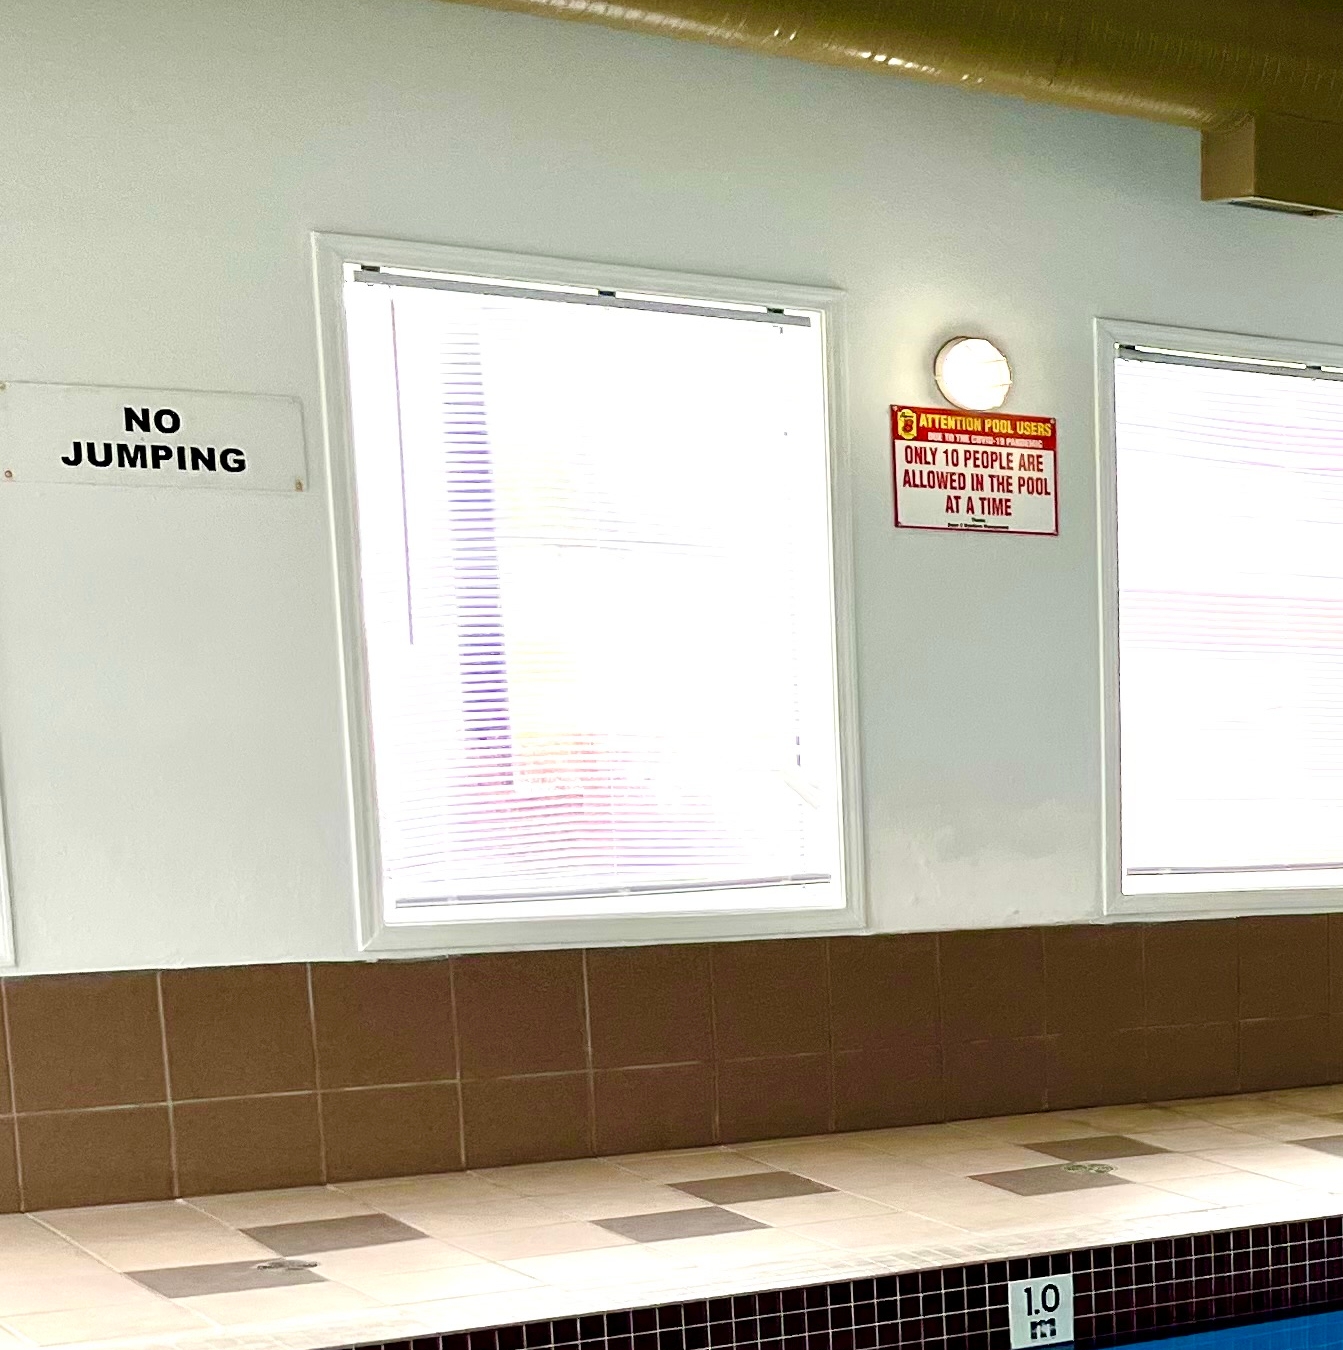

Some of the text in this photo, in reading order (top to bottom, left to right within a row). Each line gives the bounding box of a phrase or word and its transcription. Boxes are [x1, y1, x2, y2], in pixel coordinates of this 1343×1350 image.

[124, 406, 181, 434] NO
[919, 414, 982, 432] ATTENTION
[984, 419, 1014, 434] POOL
[1016, 422, 1052, 437] USERS
[61, 441, 247, 473] JUMPING
[904, 445, 1044, 472] ONLY 10 PEOPLE ARE
[902, 469, 1051, 495] ALLOWED IN THE POOL
[945, 495, 1012, 516] AT A TIME
[1023, 1283, 1060, 1317] 1.0
[1029, 1317, 1057, 1340] m
